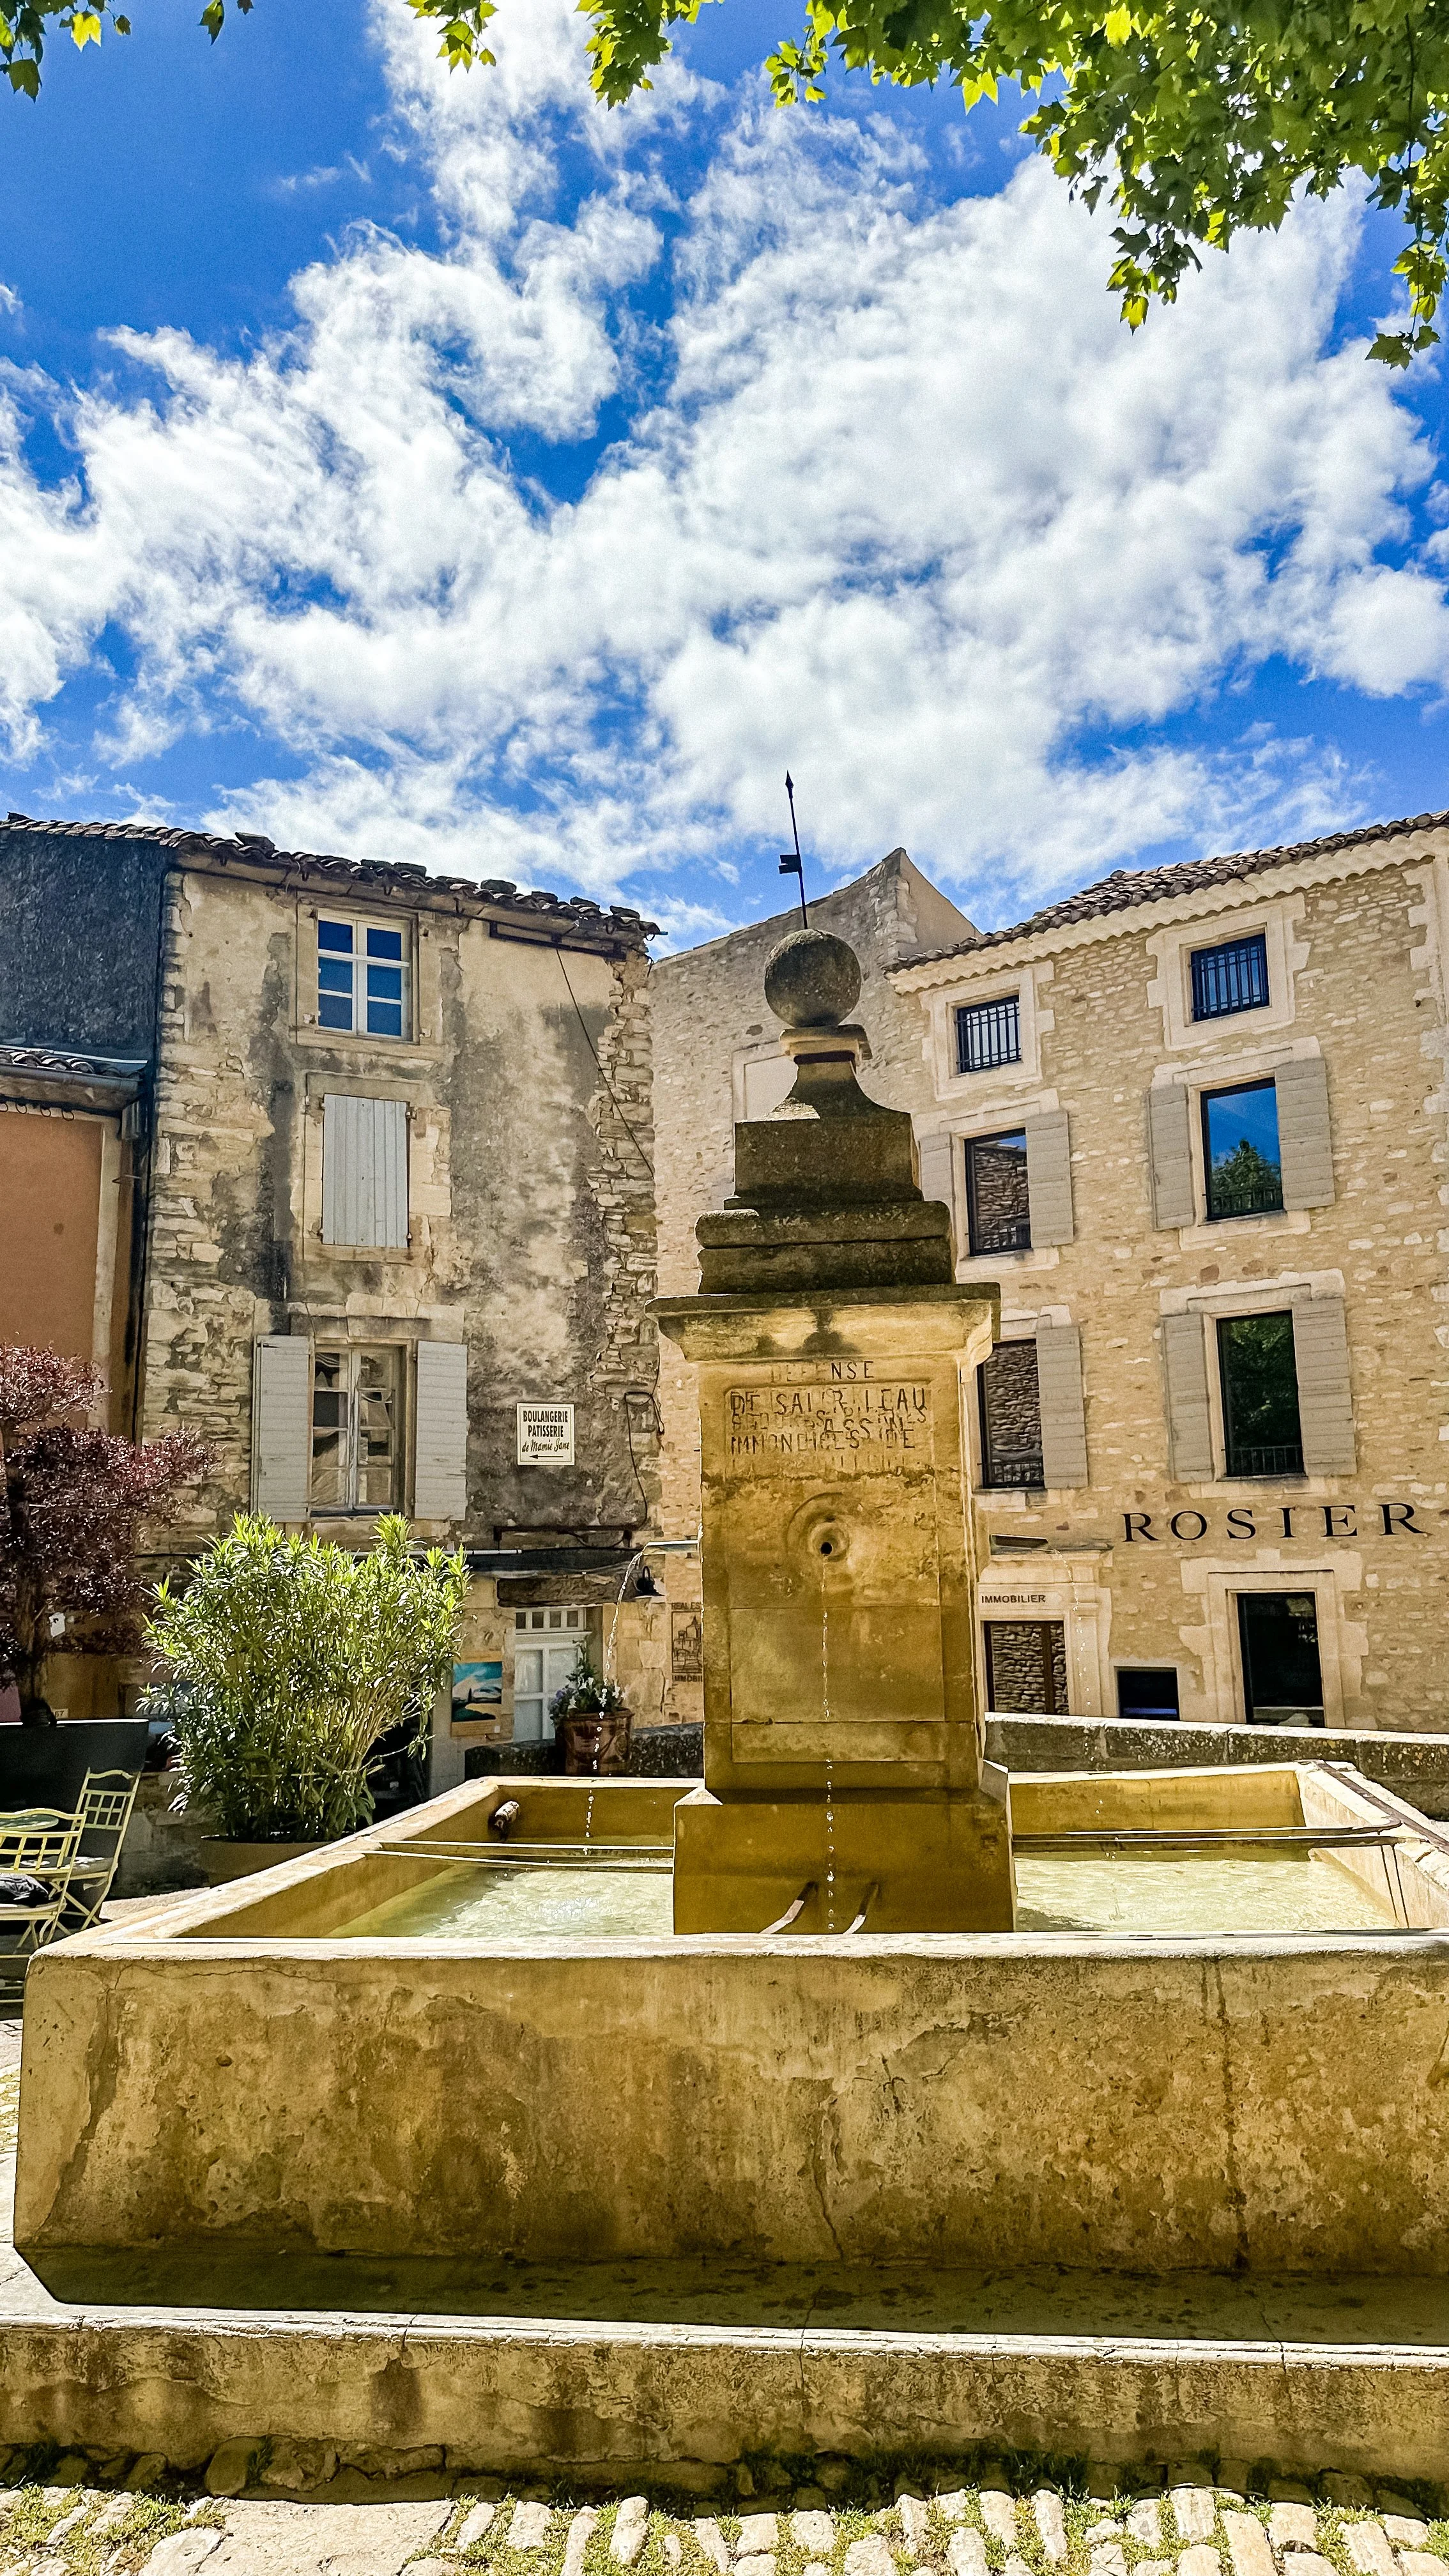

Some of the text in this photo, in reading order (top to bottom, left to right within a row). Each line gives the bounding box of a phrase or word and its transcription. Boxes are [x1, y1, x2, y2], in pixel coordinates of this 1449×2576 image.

[523, 1410, 568, 1423] BOULANGERIE
[528, 1425, 564, 1437] PATISSERIE
[522, 1441, 529, 1453] de
[530, 1439, 553, 1452] Mamie
[1121, 1502, 1427, 1543] ROSIER
[981, 1594, 1046, 1604] IMMOBILIER
